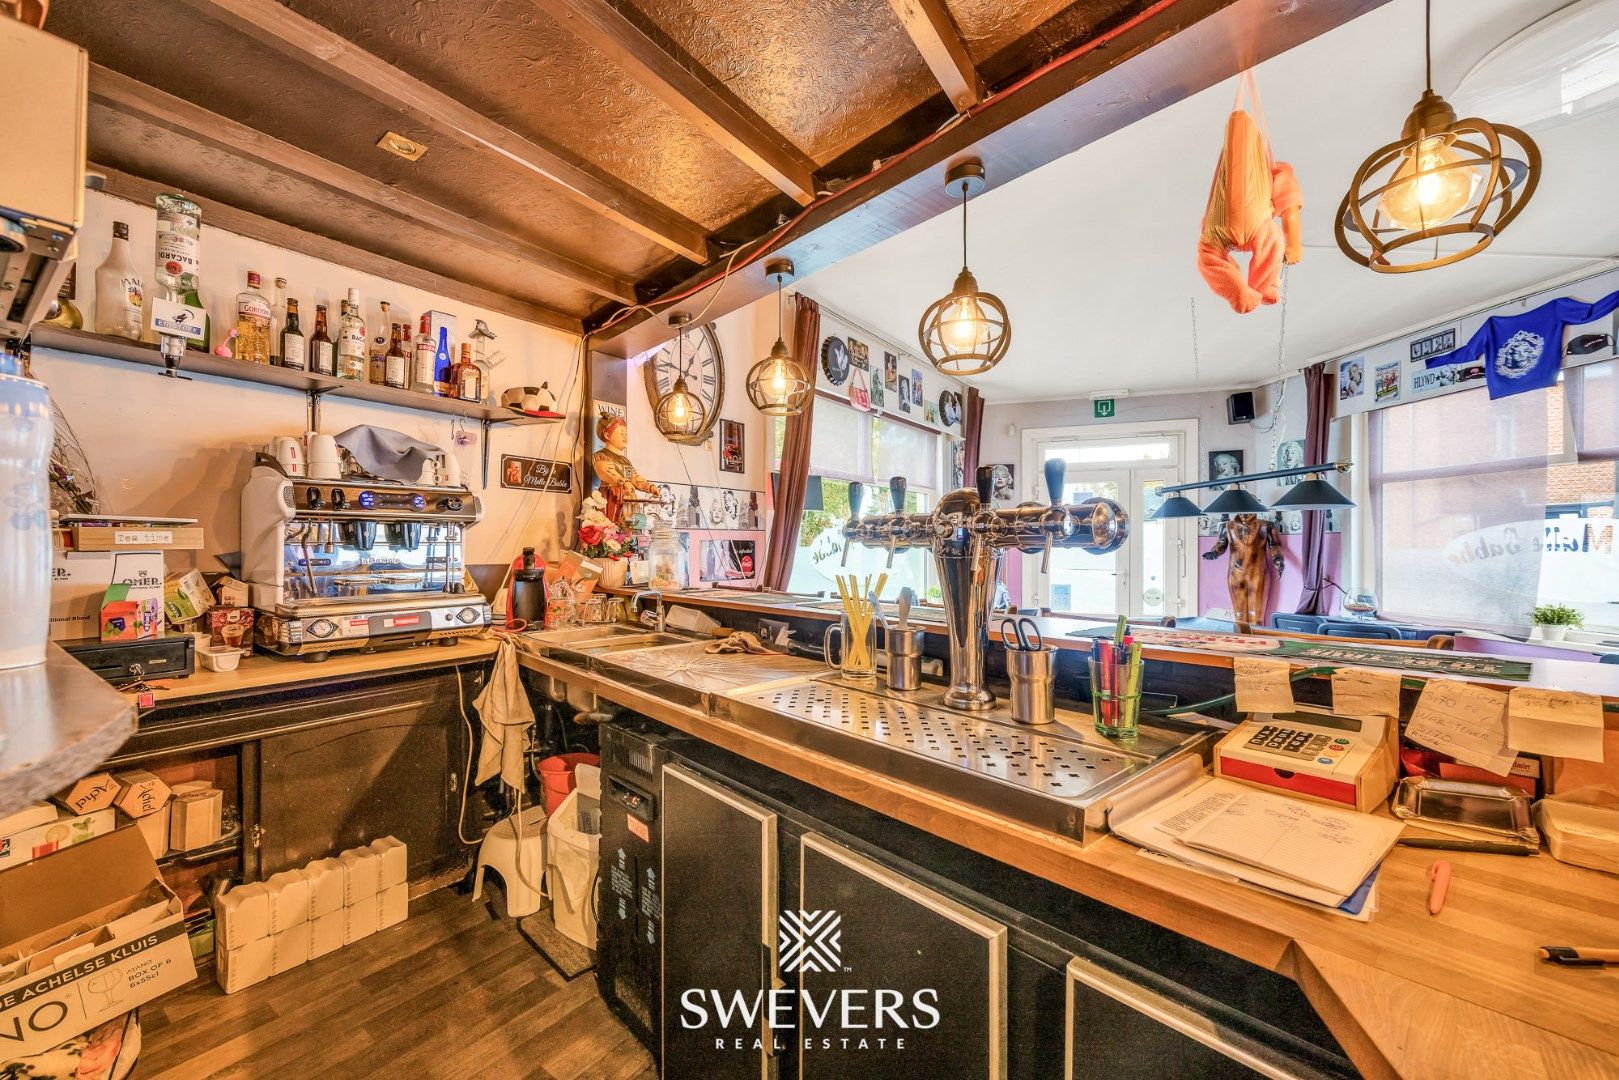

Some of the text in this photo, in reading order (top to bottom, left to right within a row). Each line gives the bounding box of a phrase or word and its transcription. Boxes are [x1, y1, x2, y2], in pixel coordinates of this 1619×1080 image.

[117, 534, 170, 542] Tea time
[22, 957, 106, 1000] ACHELSE
[111, 935, 159, 962] KLUIS
[128, 968, 148, 982] BOX
[151, 962, 164, 972] OF
